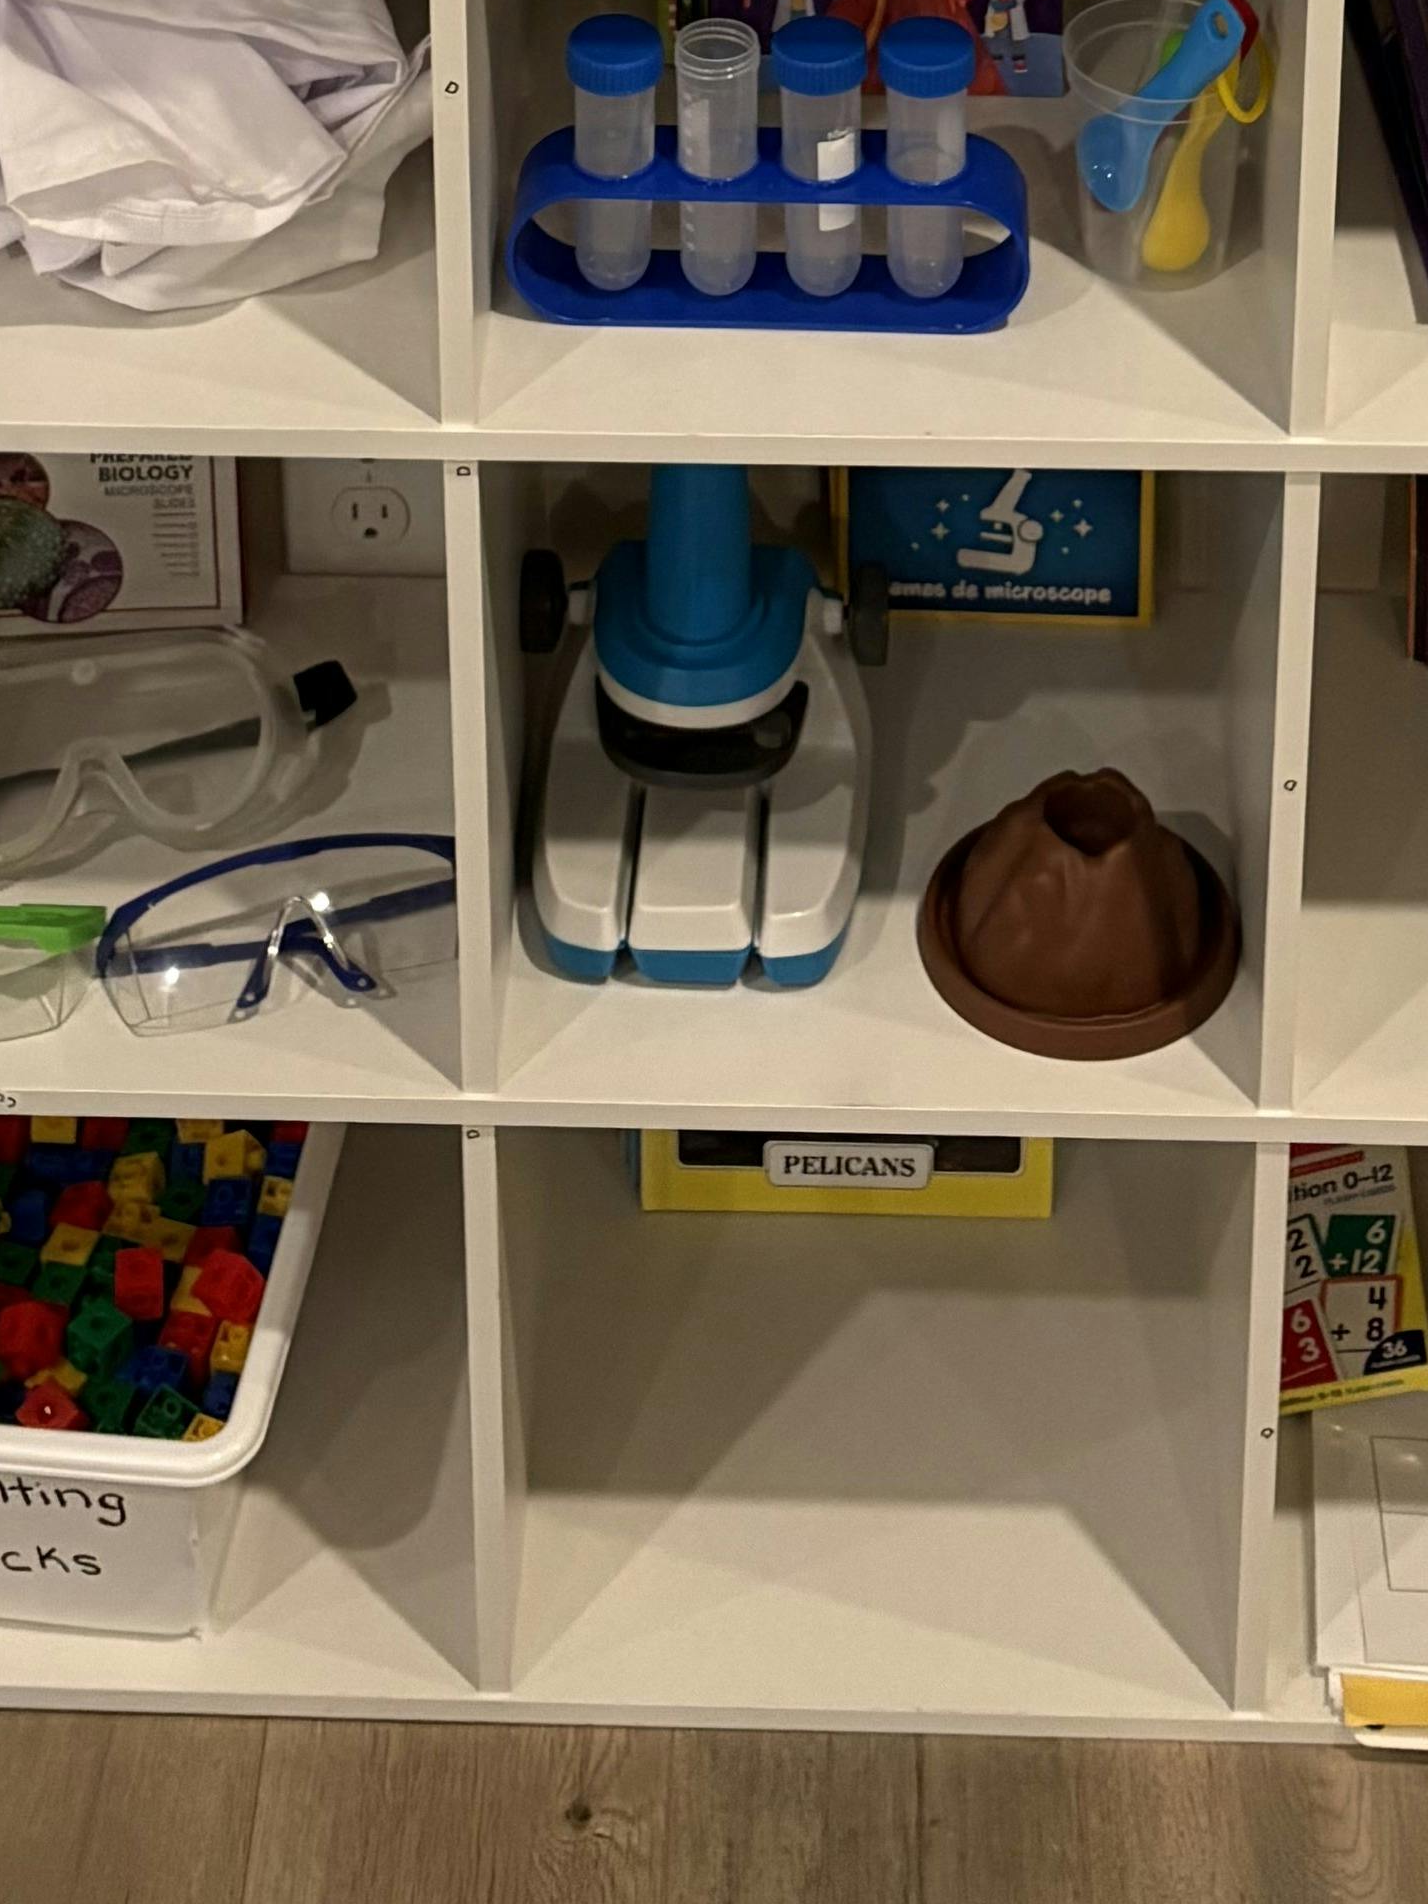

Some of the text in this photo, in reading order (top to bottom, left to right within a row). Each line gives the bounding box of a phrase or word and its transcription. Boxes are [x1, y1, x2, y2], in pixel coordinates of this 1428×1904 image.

[99, 465, 194, 482] BIOLOGY
[889, 581, 945, 597] ames
[984, 581, 1112, 605] microscope
[783, 1155, 916, 1177] PELICANS
[1287, 1229, 1306, 1252] 2
[1367, 1219, 1384, 1244] 6
[1295, 1255, 1315, 1279] 2
[1351, 1249, 1381, 1274] 12
[1369, 1286, 1386, 1311] 4
[1291, 1308, 1311, 1334] 6
[1366, 1317, 1383, 1342] 8
[1299, 1338, 1320, 1363] 3
[1381, 1340, 1408, 1359] 36
